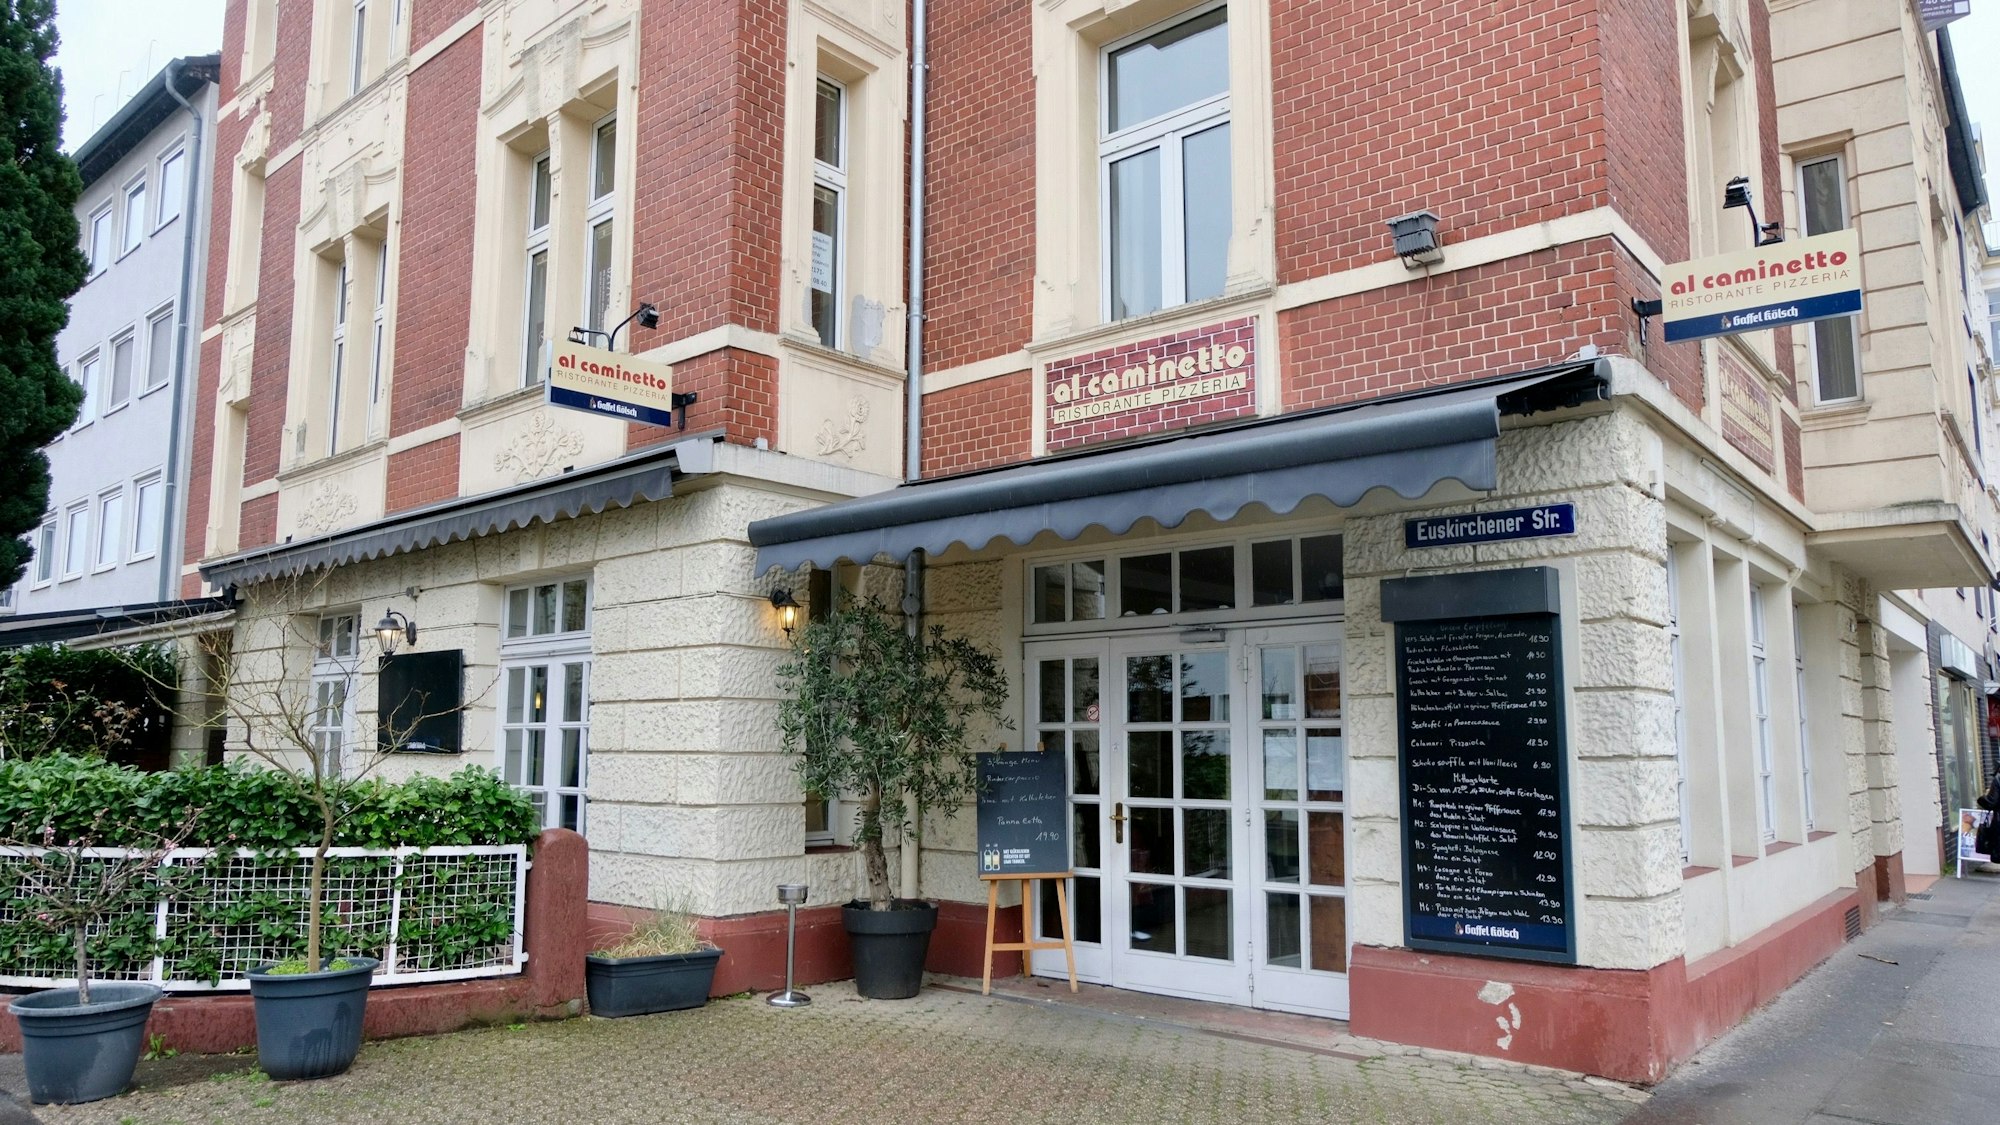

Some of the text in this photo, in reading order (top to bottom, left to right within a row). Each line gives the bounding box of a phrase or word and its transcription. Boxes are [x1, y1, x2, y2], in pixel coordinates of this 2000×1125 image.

[1671, 251, 1847, 295] al caminetto
[1671, 270, 1848, 309] RISTORANTE PIZZERIA
[1733, 305, 1799, 327] Gaffel Kölsch
[559, 354, 666, 390] al caminetto
[1053, 344, 1246, 404] al caminetto
[557, 370, 667, 401] RISTORANTE PIZZERIA
[1058, 376, 1240, 422] RISTORANTE PIZZERIA
[597, 400, 638, 418] Gaffel Kölsch
[1416, 509, 1561, 541] Euskirchener Str.
[1484, 674, 1508, 683] Spinat
[1410, 739, 1443, 747] Calamari
[1449, 738, 1486, 747] Pizzaiola
[1468, 758, 1481, 766] mit
[1532, 761, 1551, 769] 6.90
[1453, 772, 1500, 786] Mittagskarte
[1517, 788, 1554, 801] Feiertagen
[1468, 813, 1486, 823] Salat
[1538, 808, 1557, 817] 17.90
[997, 816, 1020, 825] Panna
[1036, 832, 1059, 841] 19.90
[1499, 835, 1518, 843] Salat
[1432, 843, 1462, 854] Spaghetti
[1464, 845, 1500, 856] Bolognese
[1533, 850, 1557, 861] 12.90
[1462, 855, 1482, 864] Salat
[1434, 866, 1460, 875] Lasagne
[1475, 868, 1493, 877] Forno
[1436, 873, 1450, 881] dazu
[1467, 876, 1487, 885] Salat
[1539, 899, 1561, 908] 13.90
[1435, 903, 1453, 912] Pizza
[1454, 906, 1464, 914] mit
[1540, 915, 1563, 924] 13.90
[1464, 924, 1520, 940] Gaffel Kölsch
